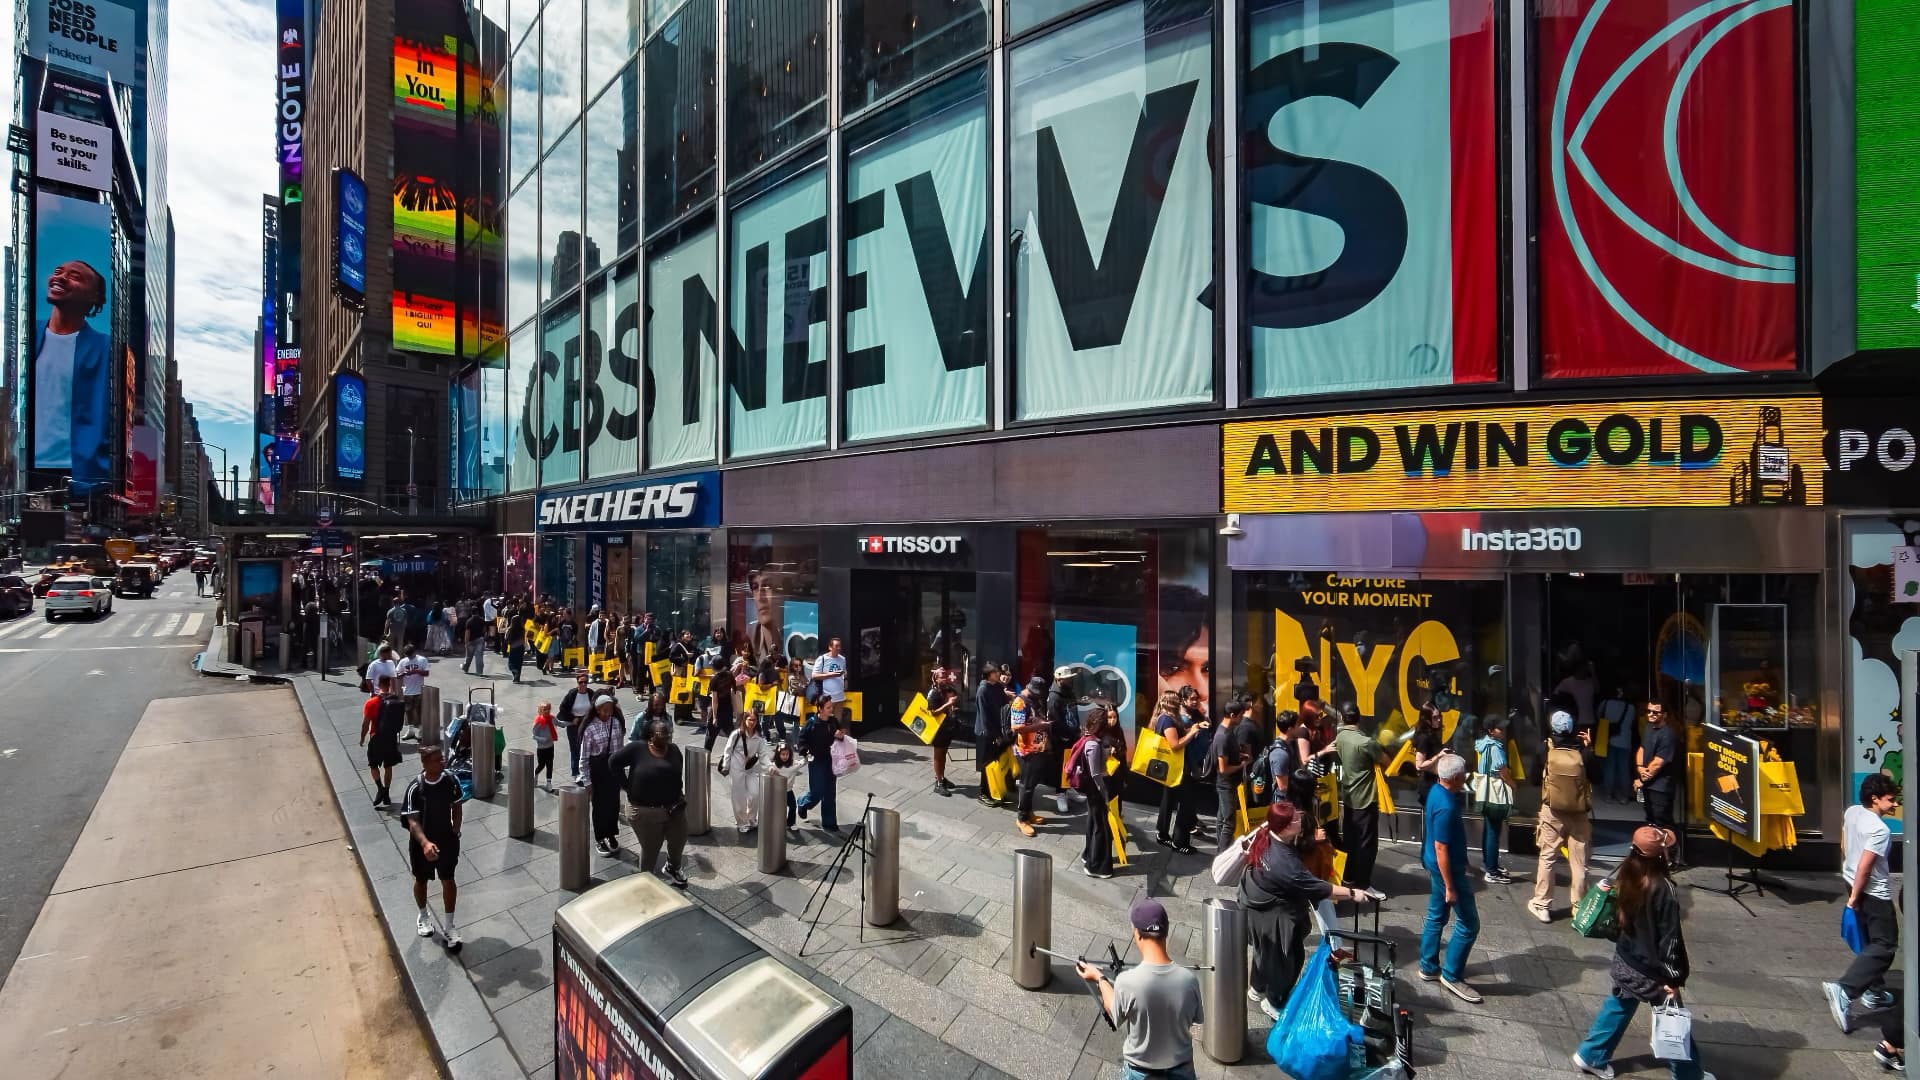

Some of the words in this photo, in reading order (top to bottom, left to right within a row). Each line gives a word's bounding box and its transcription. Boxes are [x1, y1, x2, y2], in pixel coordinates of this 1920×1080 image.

[49, 7, 95, 31] NEED
[49, 20, 117, 53] PEOPLE
[48, 43, 92, 65] indeed
[416, 49, 434, 76] in
[406, 74, 445, 103] You.
[50, 127, 67, 141] Be
[69, 133, 98, 149] seen
[51, 142, 68, 154] for
[70, 147, 98, 161] your
[57, 157, 91, 172] skills.
[522, 301, 656, 461] CBS
[682, 41, 1408, 426] NEWS
[416, 321, 432, 329] QUI
[277, 348, 301, 360] ENERGY
[1245, 426, 1381, 476] AND
[1393, 421, 1528, 476] WIN
[1547, 413, 1724, 469] GOLD
[539, 481, 698, 525] SKECHERS
[883, 536, 961, 553] TISSOT
[1462, 527, 1582, 551] Insta360
[1326, 573, 1405, 589] CAPTURE
[1302, 591, 1349, 606] YOUR
[1354, 592, 1432, 608] MOMENT
[1276, 608, 1461, 745] NYC
[1708, 741, 1722, 753] GET
[1717, 760, 1739, 775] GOLD
[1719, 753, 1736, 767] WIN
[566, 952, 604, 1011] RIVETING
